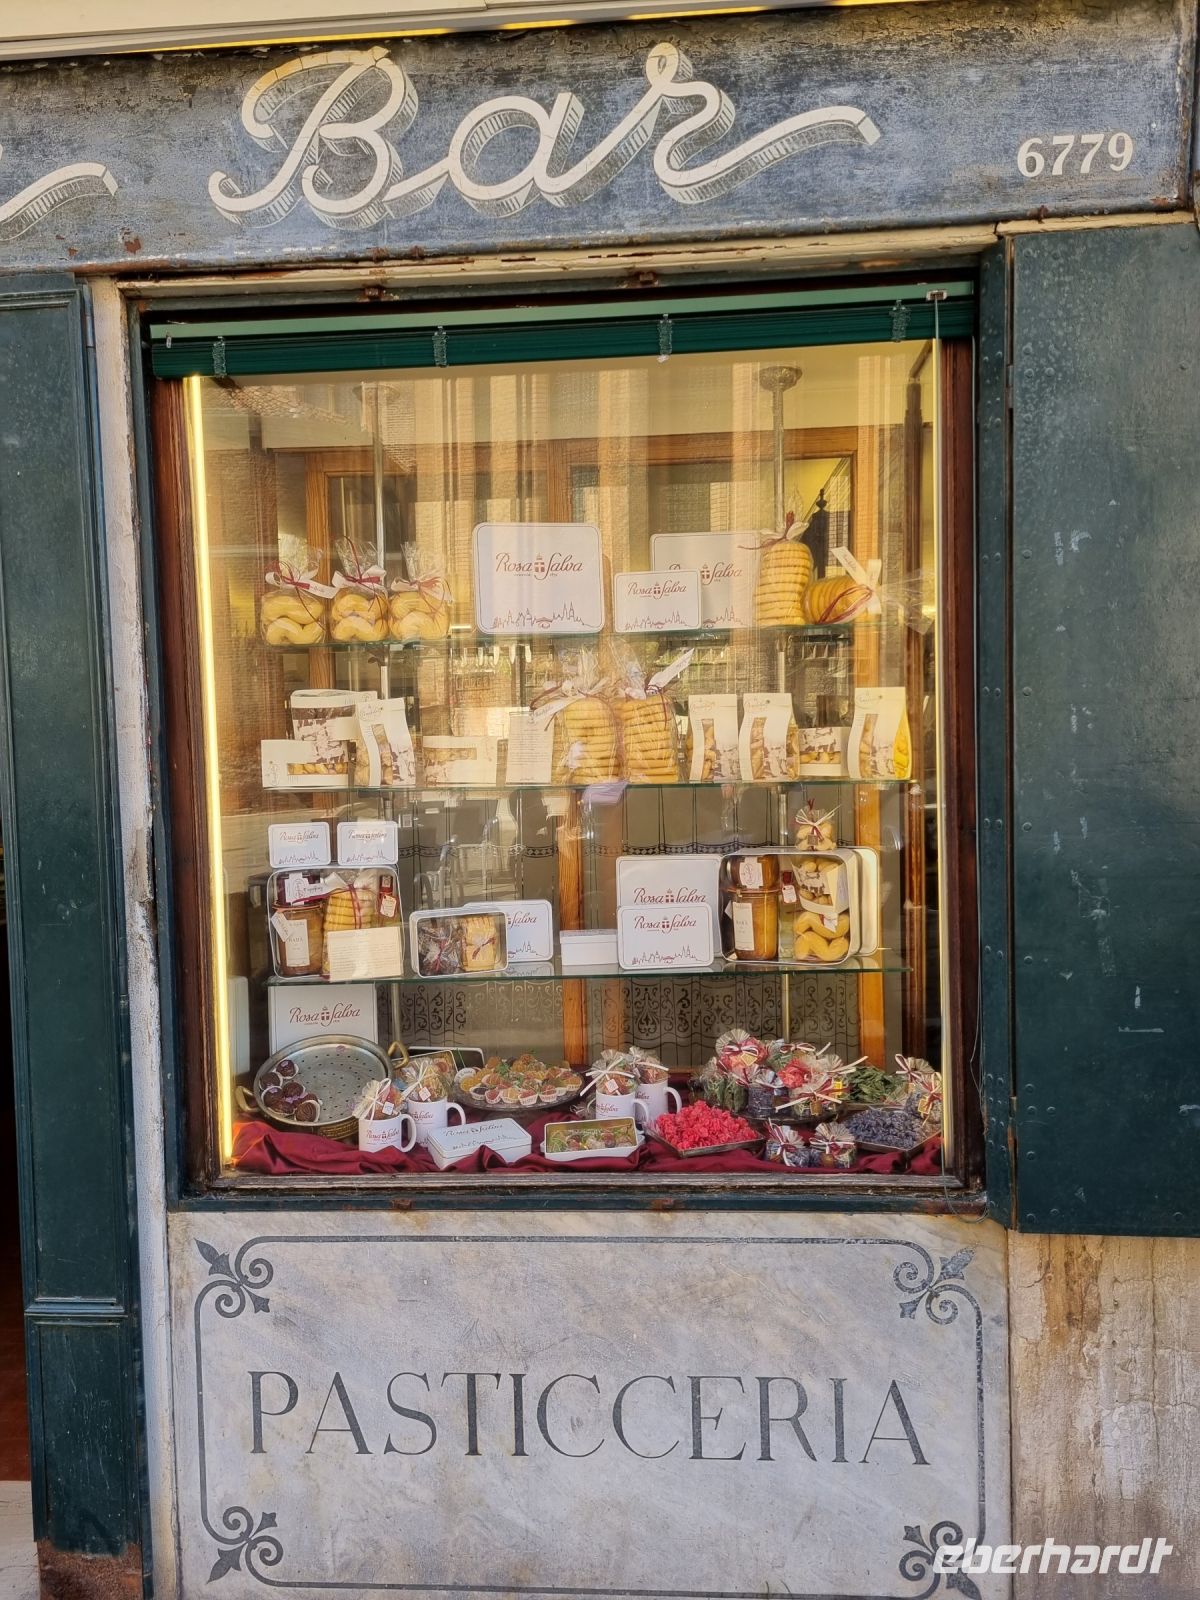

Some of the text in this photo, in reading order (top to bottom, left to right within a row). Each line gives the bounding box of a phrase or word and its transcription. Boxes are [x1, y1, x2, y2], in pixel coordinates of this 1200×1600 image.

[208, 43, 881, 229] Bar
[1016, 131, 1134, 178] 6779
[495, 552, 584, 580] Rosa Salva
[701, 562, 742, 585] Salva
[628, 580, 687, 600] Rosa Salva
[634, 886, 706, 904] Rosa Salva
[634, 913, 697, 934] Rosa Salva
[289, 1002, 361, 1027] Rosa Salva
[248, 1371, 931, 1465] PASTICCERIA
